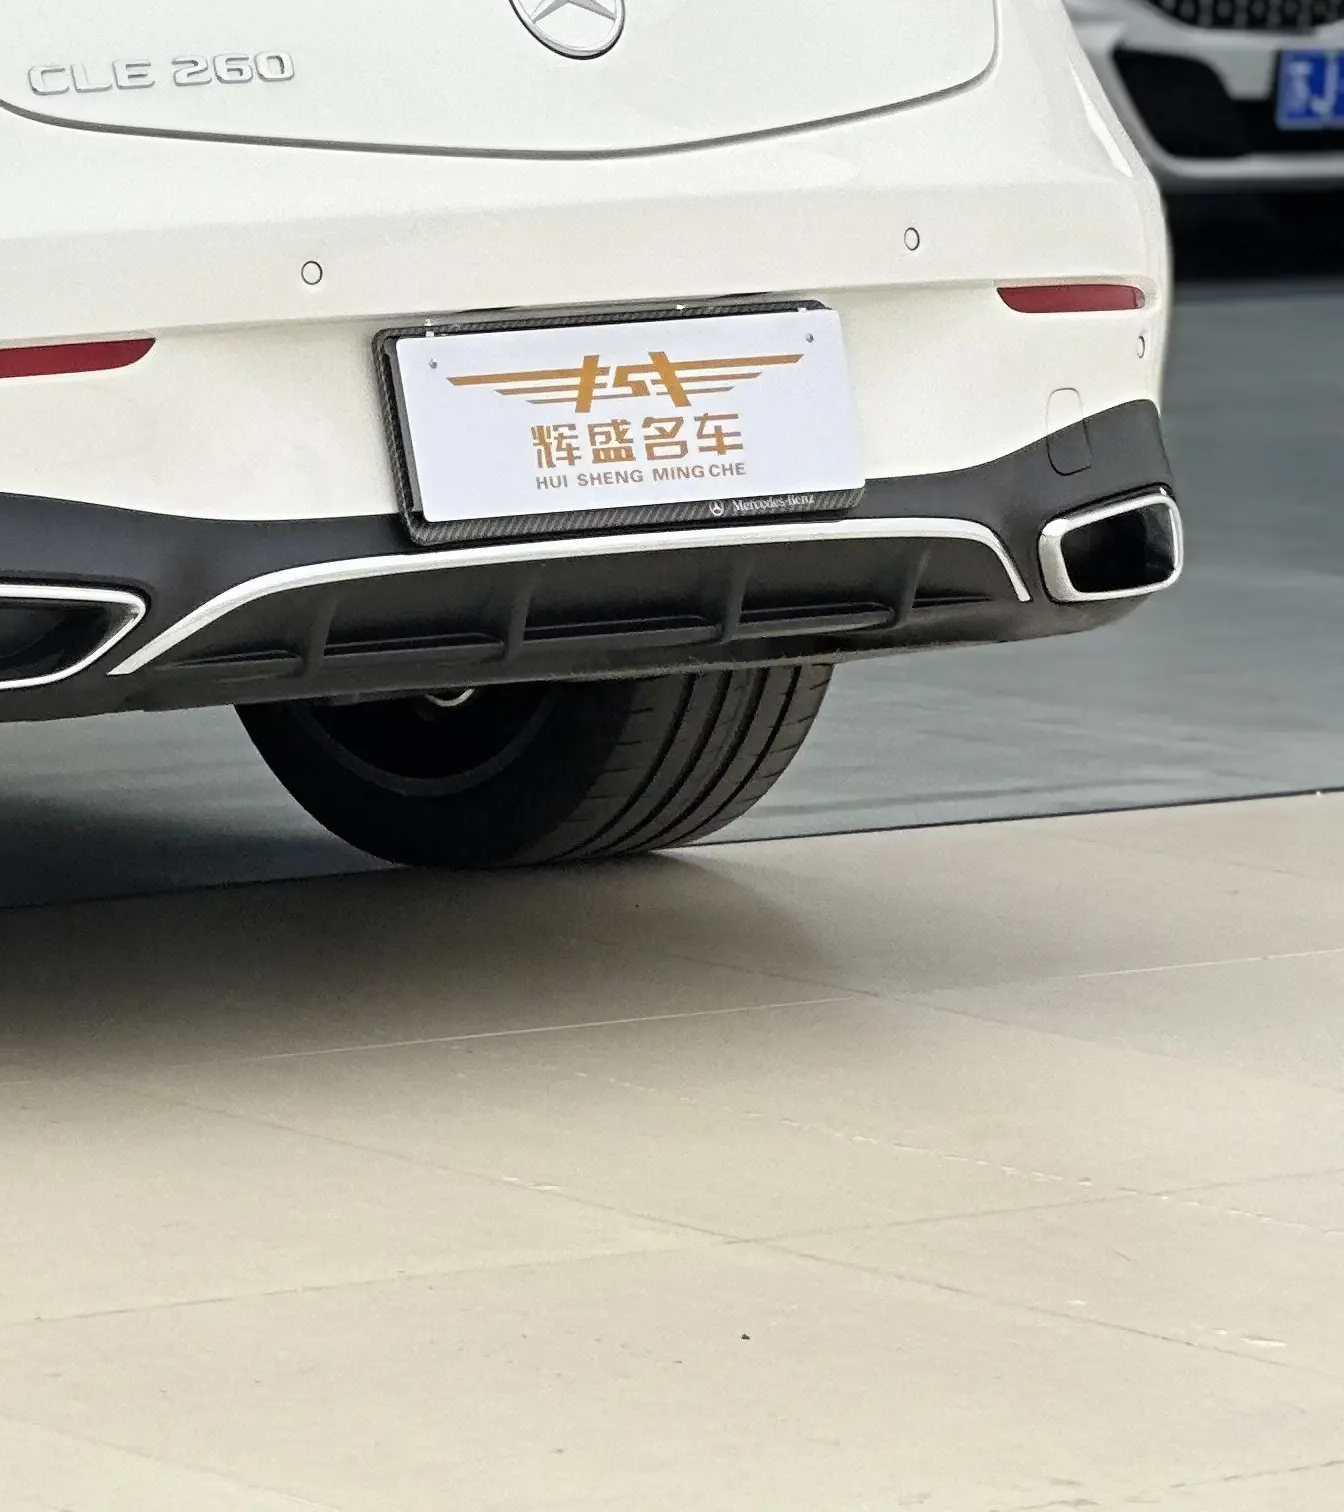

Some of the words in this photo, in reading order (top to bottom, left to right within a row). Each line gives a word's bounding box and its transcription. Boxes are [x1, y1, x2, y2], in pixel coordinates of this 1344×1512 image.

[28, 59, 155, 96] CLE
[171, 51, 296, 87] 260
[530, 412, 744, 468] 辉盛名车
[535, 475, 568, 490] HUI
[576, 469, 644, 487] SHENG
[652, 464, 705, 482] MING
[709, 462, 747, 478] CHE
